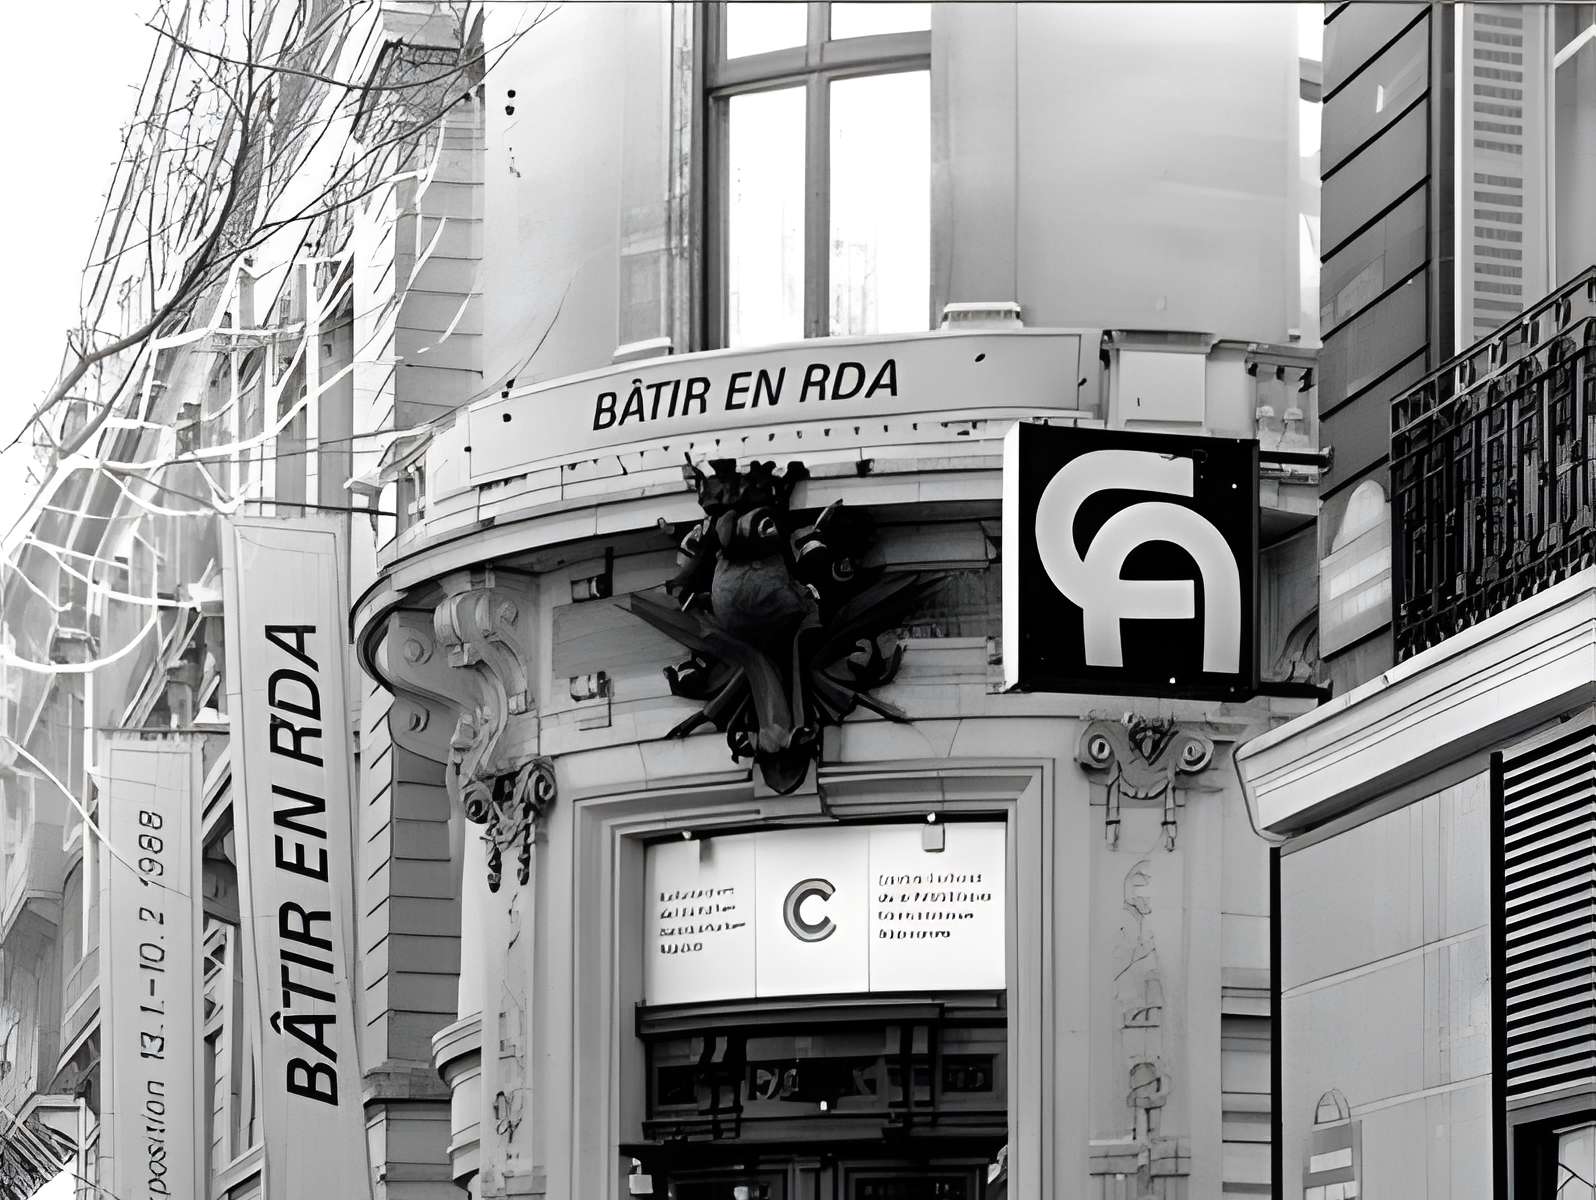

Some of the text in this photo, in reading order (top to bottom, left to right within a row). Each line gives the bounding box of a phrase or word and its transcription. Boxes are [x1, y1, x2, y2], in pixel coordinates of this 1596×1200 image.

[593, 359, 898, 431] BÂTIR EN RDA
[265, 625, 338, 1106] BÂTIR EN RDA
[783, 878, 837, 942] C
